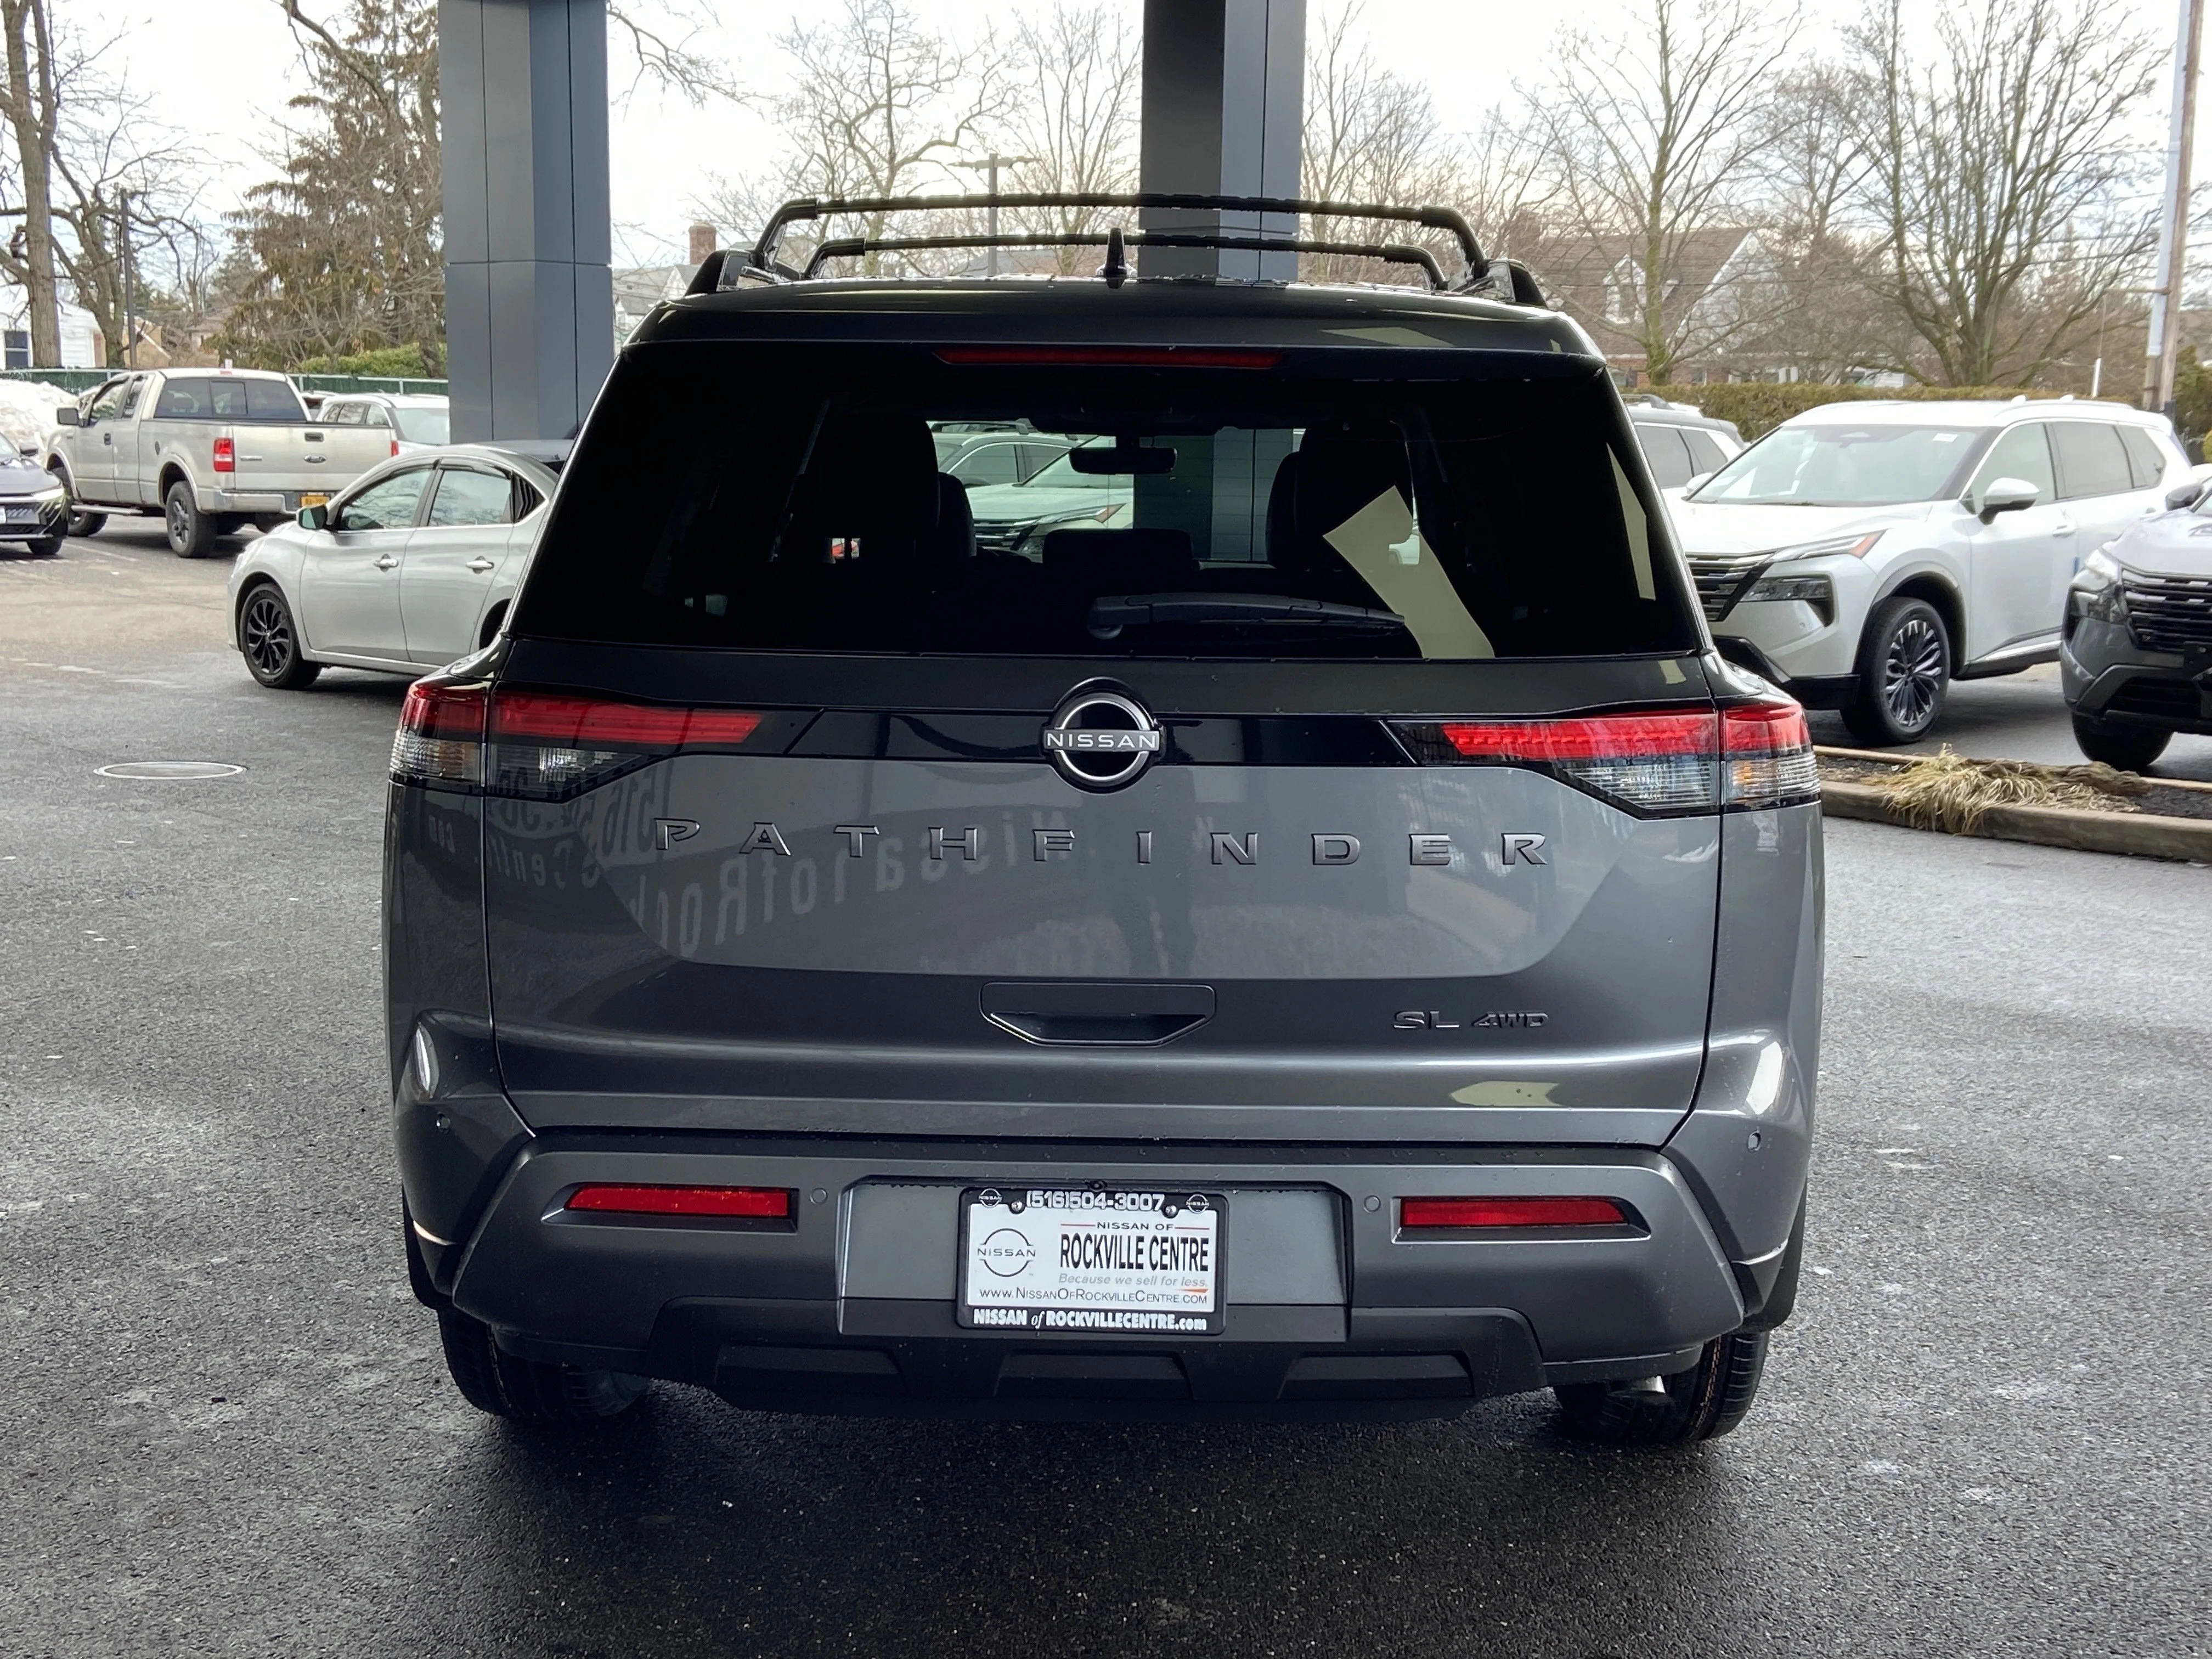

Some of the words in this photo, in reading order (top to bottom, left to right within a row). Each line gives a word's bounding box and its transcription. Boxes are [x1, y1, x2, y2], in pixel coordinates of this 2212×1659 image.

[1046, 732, 1156, 748] NISSAN
[653, 817, 1549, 867] PATHFINDER
[1393, 1011, 1460, 1029] SL
[1471, 1011, 1548, 1028] 4WD
[1026, 1190, 1165, 1211] (516)504-3007
[1097, 1222, 1149, 1230] NISSAN
[978, 1248, 1036, 1257] NISSAN
[1060, 1233, 1144, 1270] ROCKVILLE
[1149, 1234, 1209, 1272] CENTRE
[1059, 1273, 1111, 1284] Because
[1115, 1276, 1132, 1285] we
[1136, 1276, 1158, 1286] sell
[1161, 1276, 1178, 1286] for
[1181, 1277, 1207, 1287] less.
[974, 1308, 1028, 1325] NISSAN
[1031, 1311, 1045, 1329] of
[1046, 1311, 1207, 1330] ROCKVILLECENTRE.com
